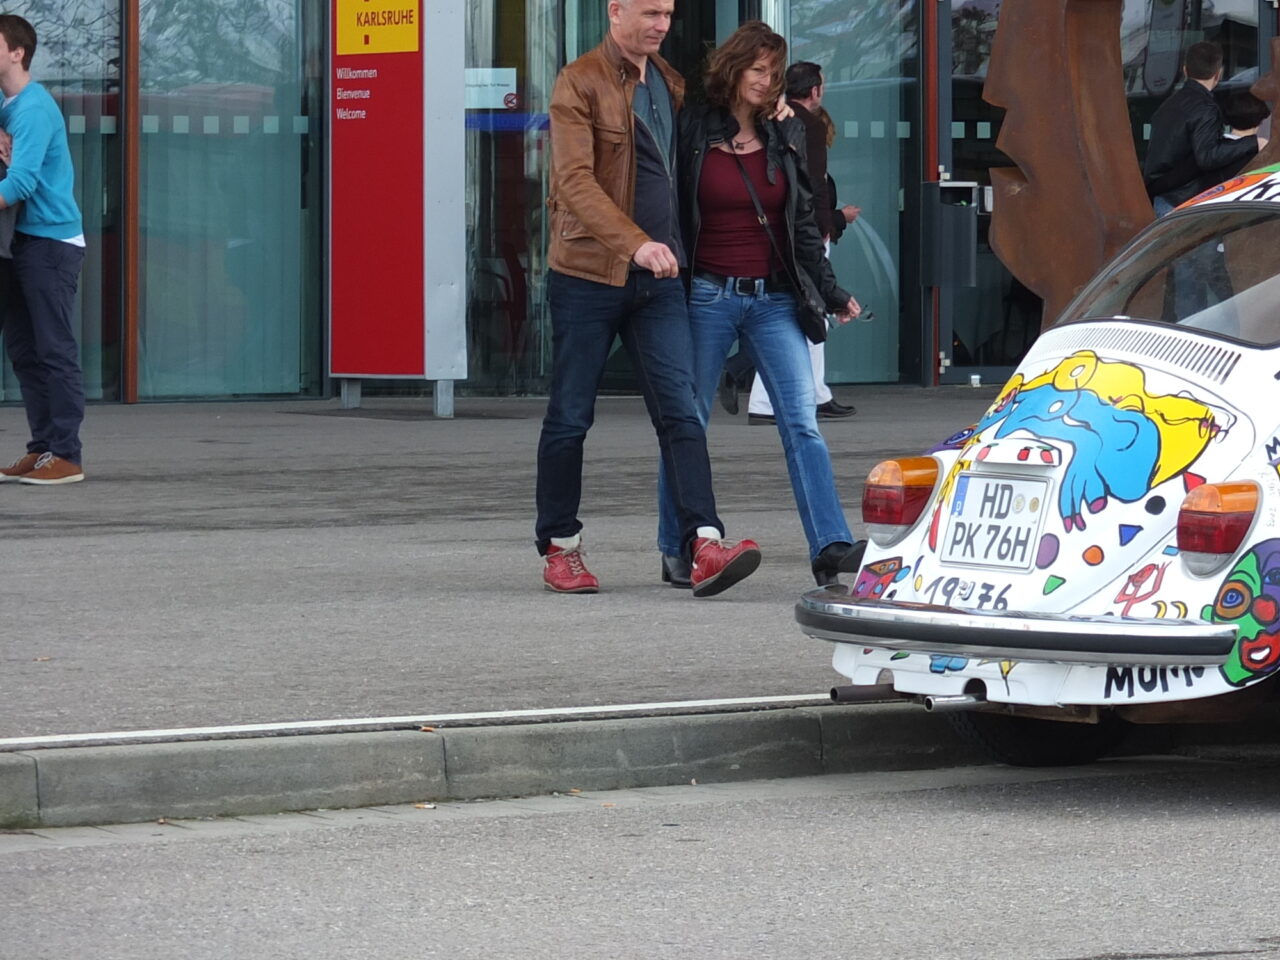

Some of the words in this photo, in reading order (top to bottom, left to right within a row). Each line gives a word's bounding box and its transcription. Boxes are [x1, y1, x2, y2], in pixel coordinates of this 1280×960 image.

[356, 9, 414, 27] KARLSRUHE
[336, 67, 378, 80] Willkommen
[336, 87, 371, 100] Bienvenue
[336, 107, 367, 120] Welcome
[979, 482, 1014, 520] HD
[948, 521, 983, 559] PK
[983, 524, 1032, 563] 76H
